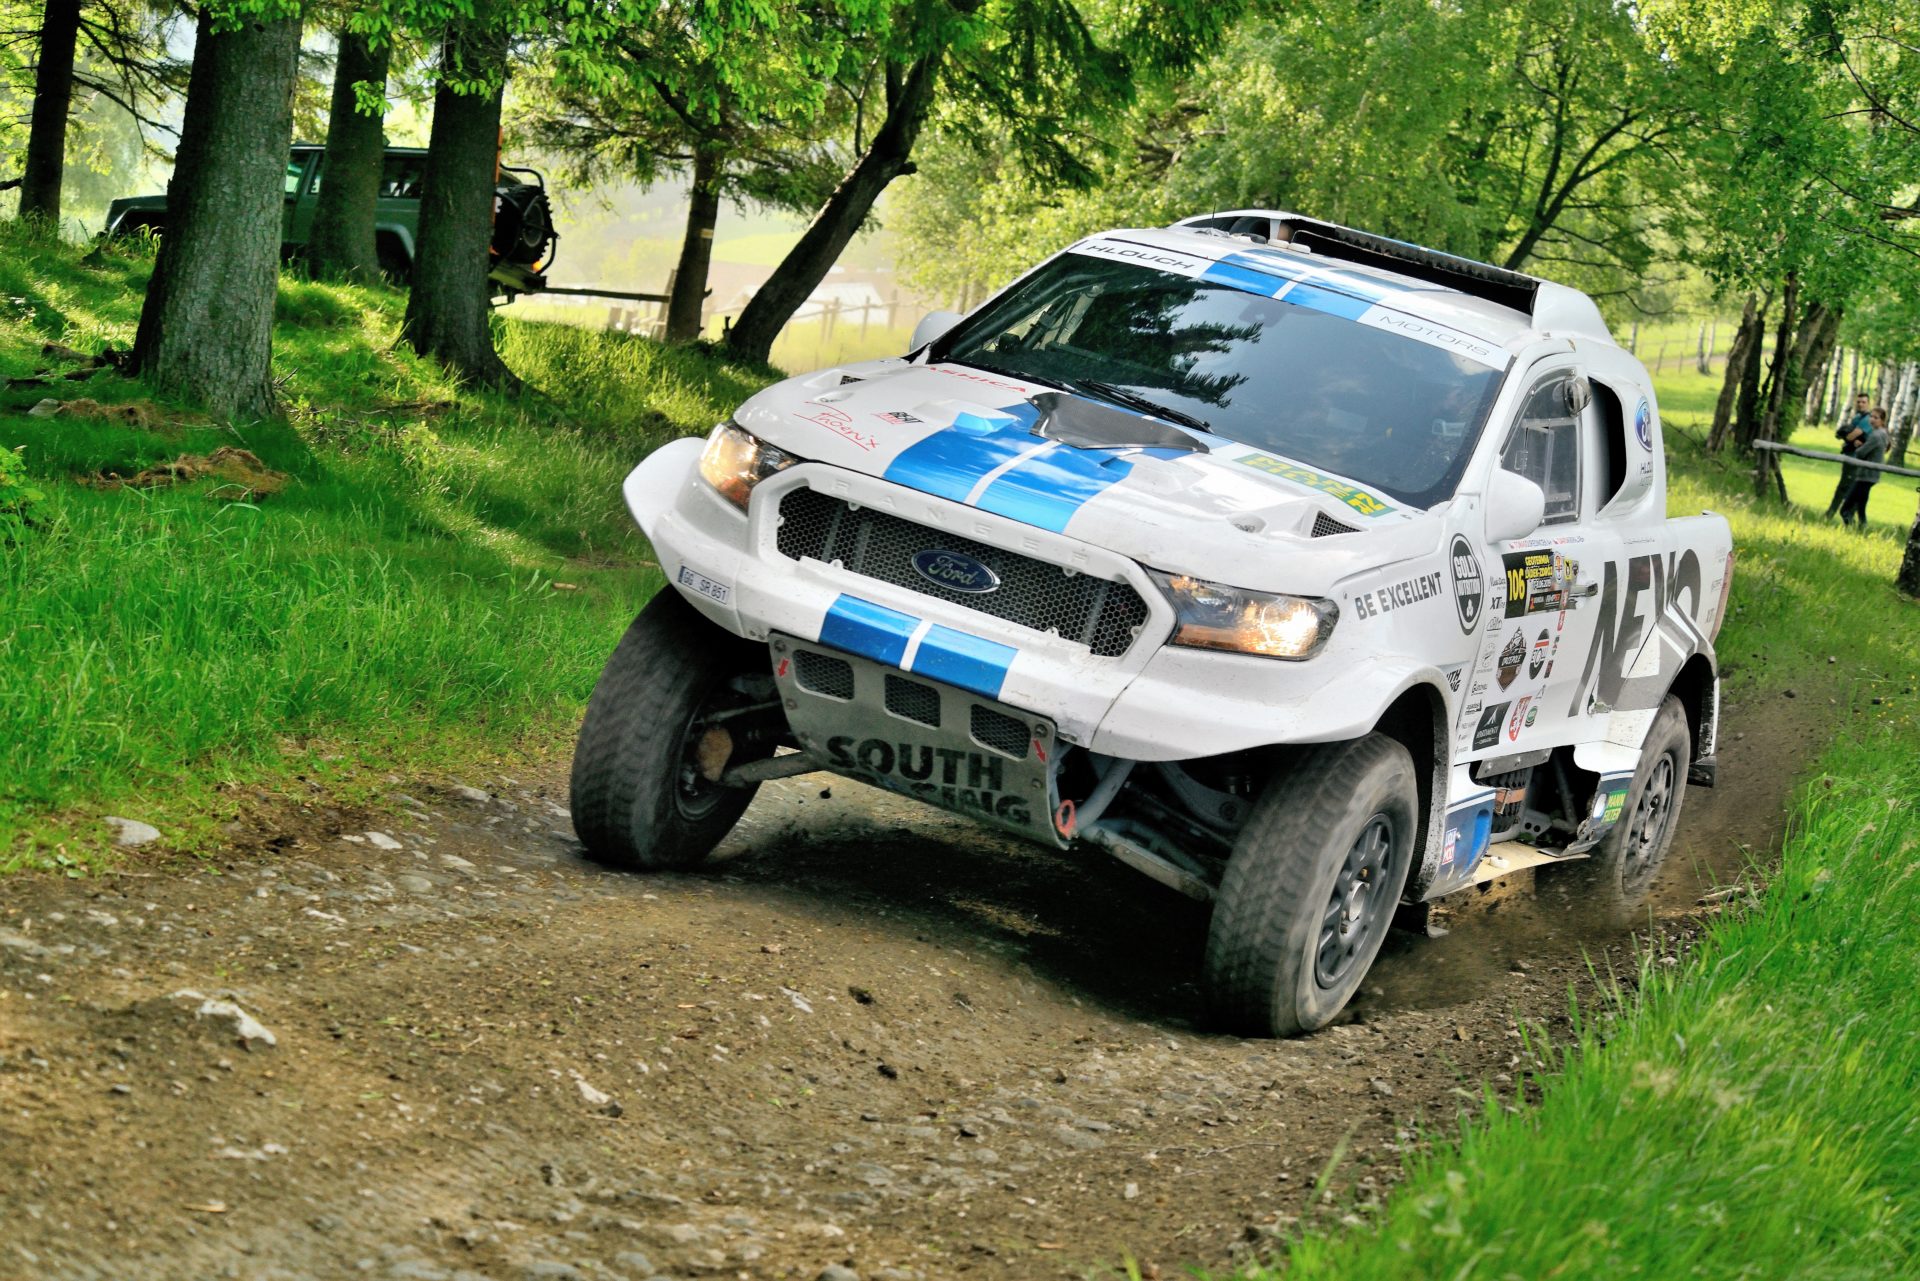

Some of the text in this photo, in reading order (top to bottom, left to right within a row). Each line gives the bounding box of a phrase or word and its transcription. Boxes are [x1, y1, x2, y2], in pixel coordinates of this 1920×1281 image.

[1086, 245, 1195, 270] HLOUCH
[1379, 315, 1491, 356] MOTORS
[831, 478, 1090, 565] RANGER
[926, 555, 978, 584] Ford
[1508, 568, 1525, 601] 106
[700, 579, 711, 593] SR
[711, 585, 726, 601] 851
[1355, 571, 1442, 620] BE EXCELLENT
[826, 736, 1003, 791] SOUTH
